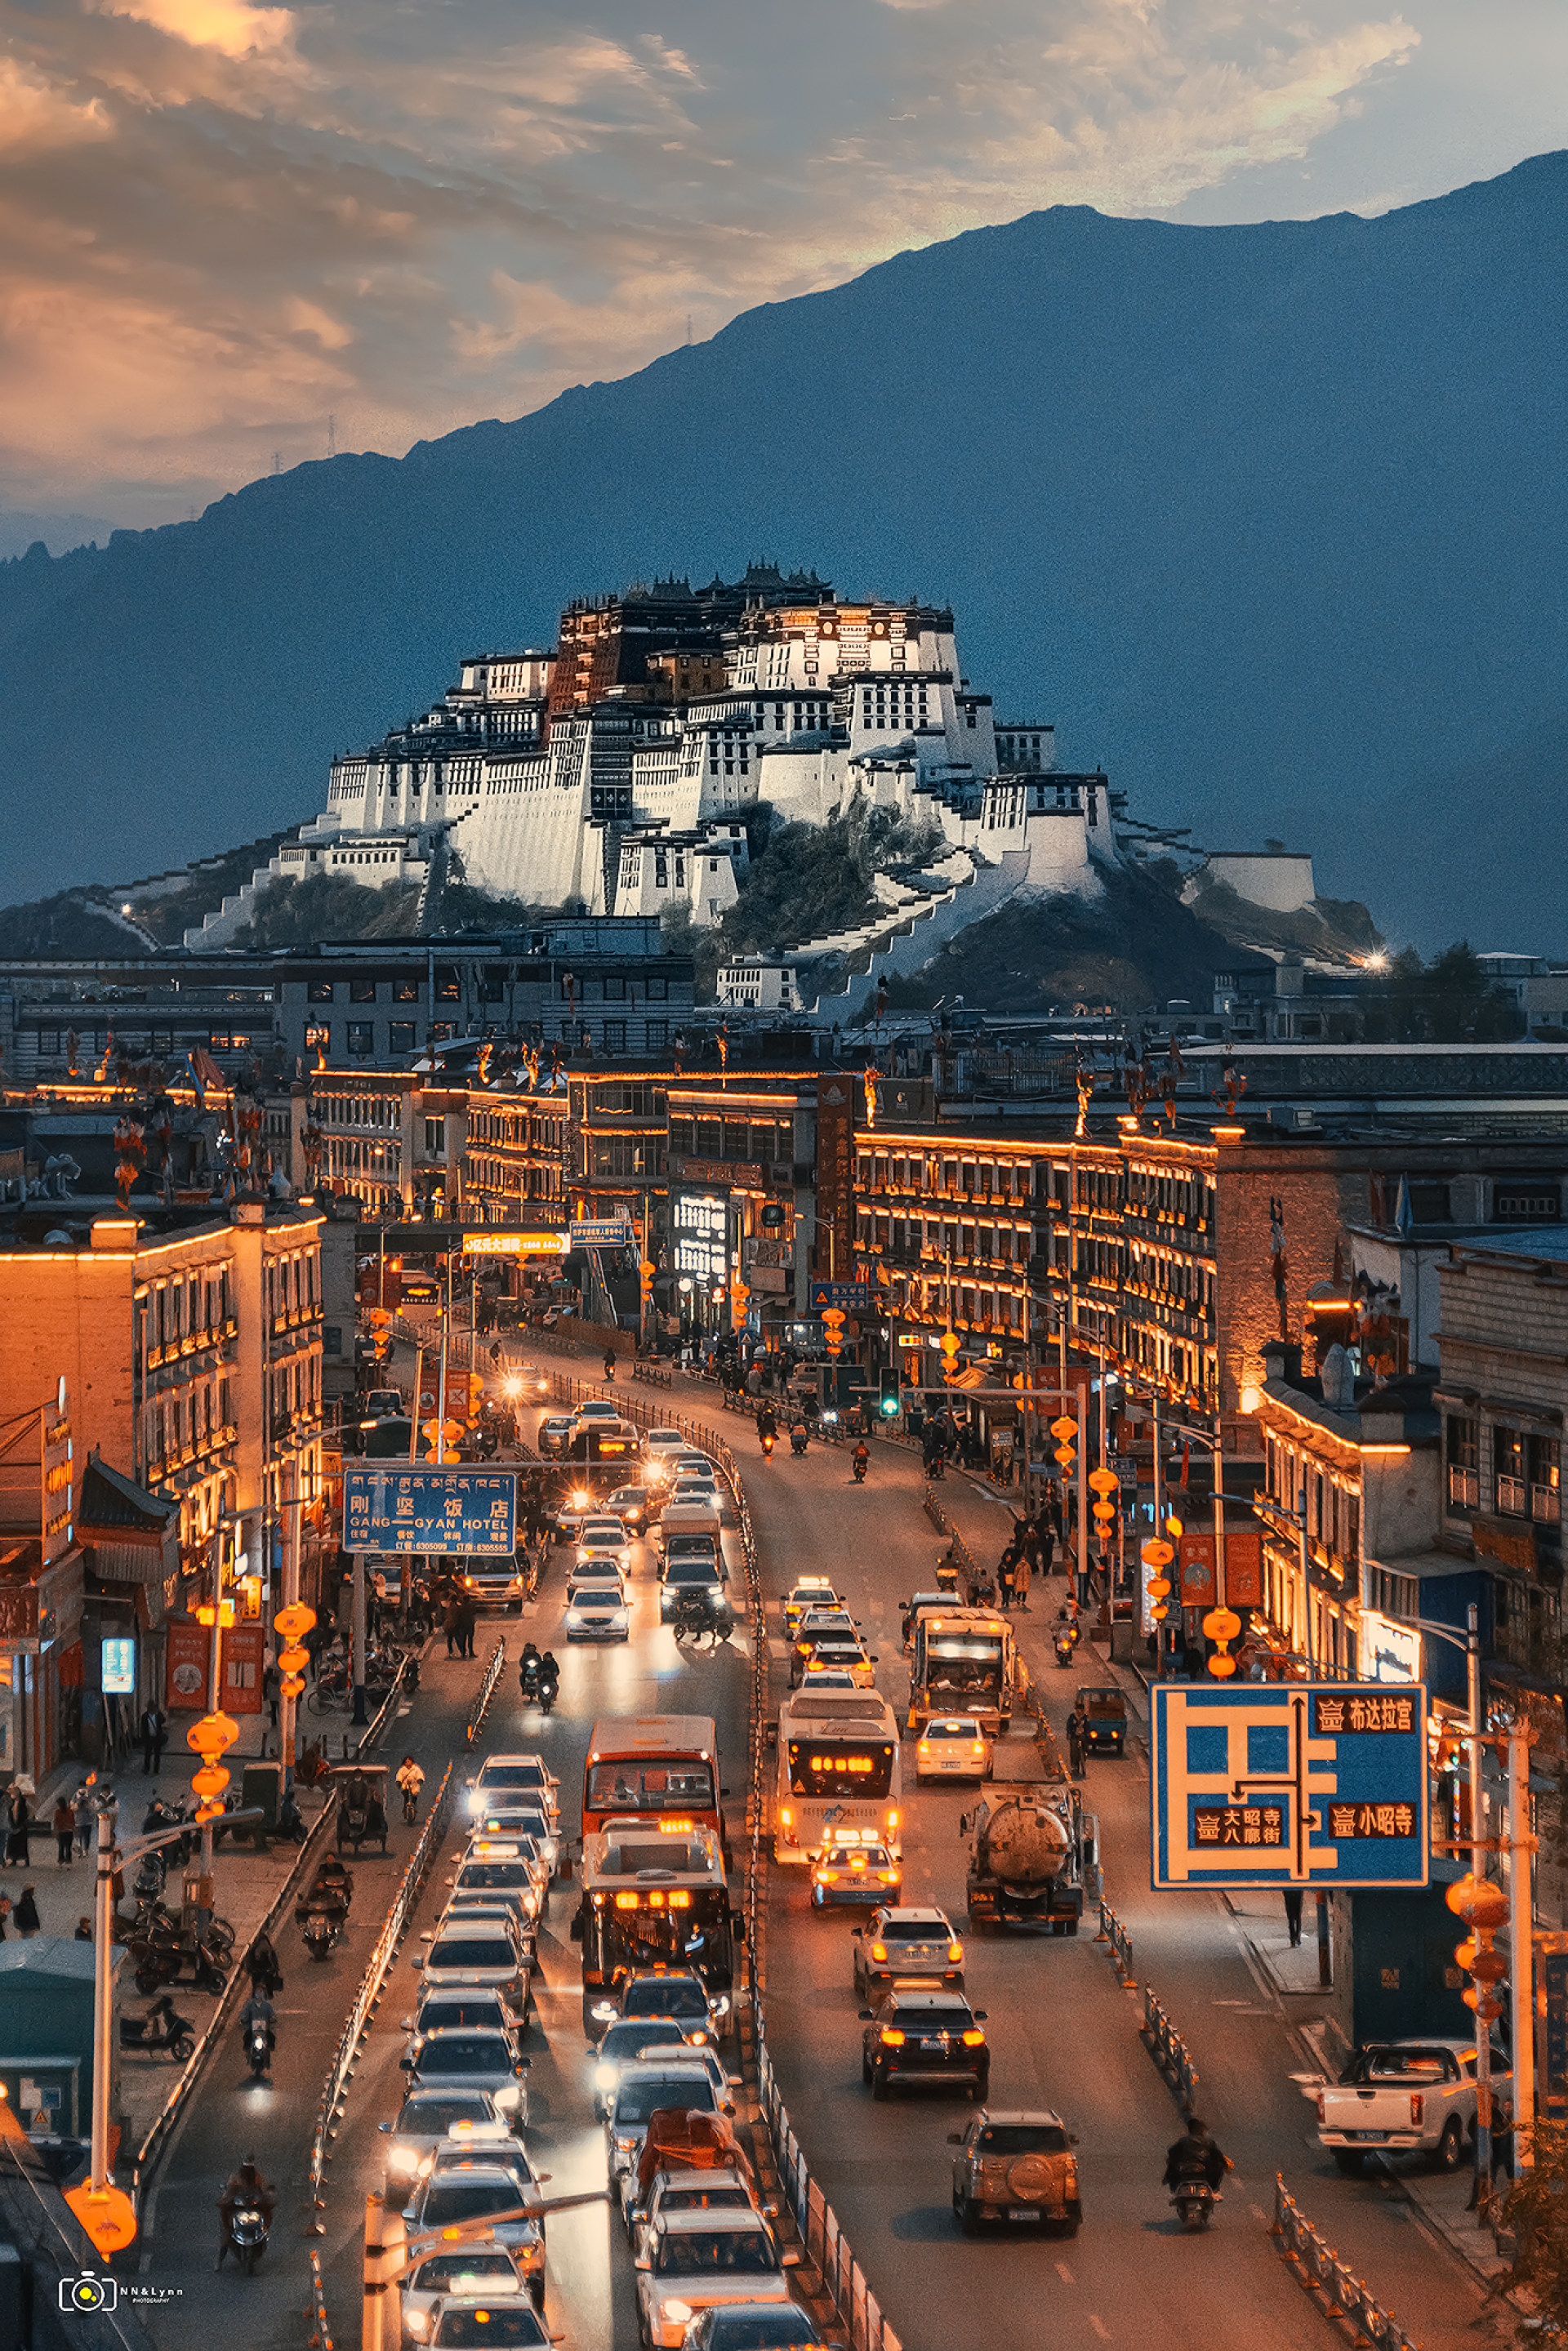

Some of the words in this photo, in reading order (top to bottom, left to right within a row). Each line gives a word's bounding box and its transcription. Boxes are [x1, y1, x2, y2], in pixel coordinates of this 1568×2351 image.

[350, 1495, 508, 1519] 刚坚饭店
[462, 1520, 508, 1530] HOTEL
[350, 1529, 368, 1538] 住宿
[397, 1530, 415, 1539] 餐饮
[443, 1532, 461, 1541] 休闲
[1350, 1699, 1412, 1730] 布达拉宫
[1223, 1810, 1281, 1826] 大昭寺
[1359, 1805, 1412, 1837] 小昭寺
[1223, 1827, 1281, 1844] 八廓街
